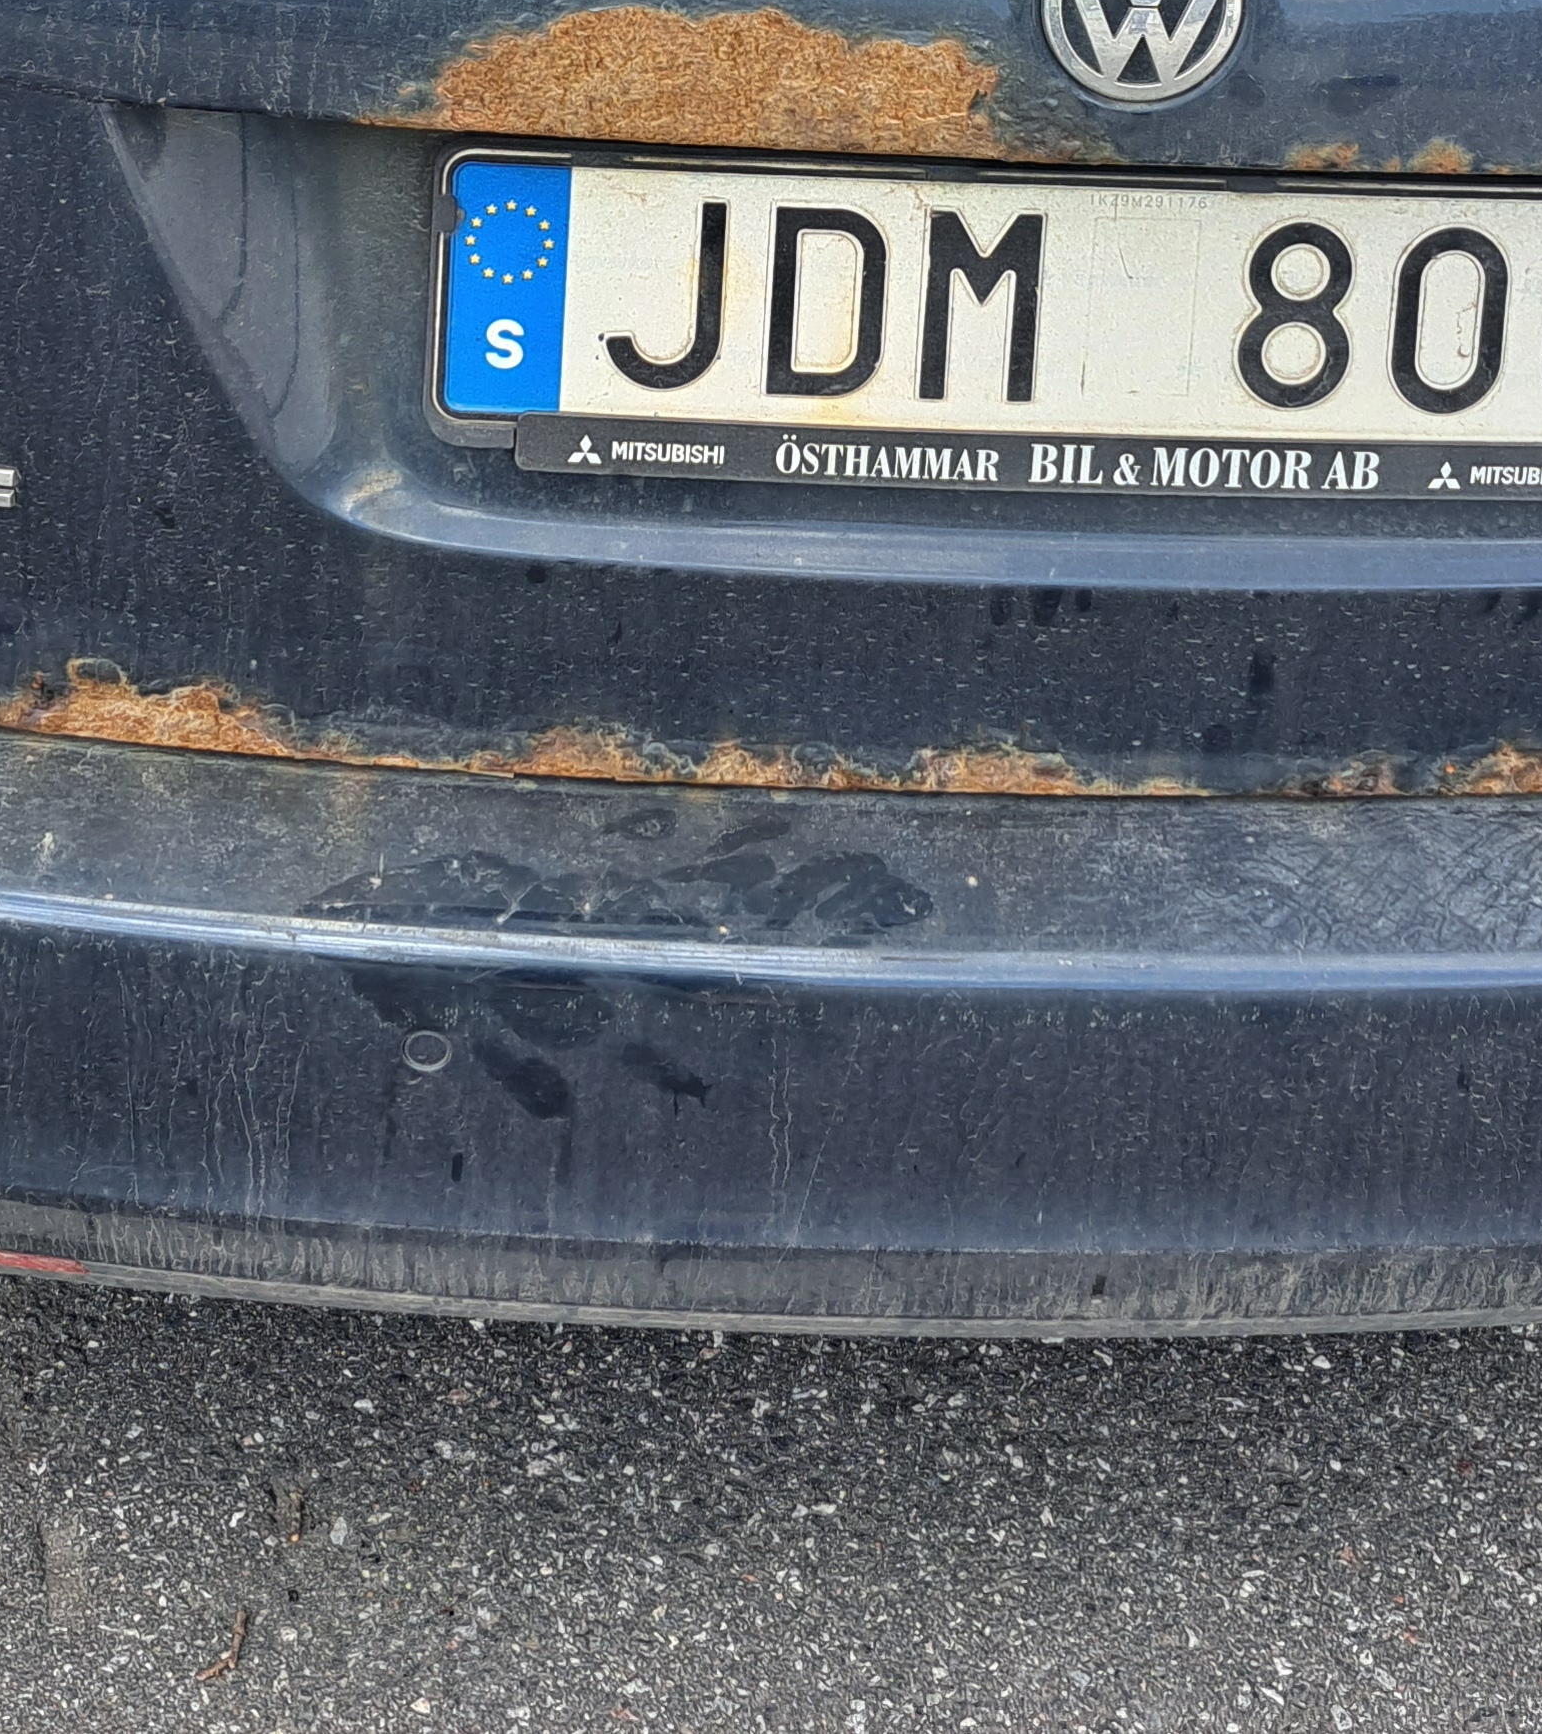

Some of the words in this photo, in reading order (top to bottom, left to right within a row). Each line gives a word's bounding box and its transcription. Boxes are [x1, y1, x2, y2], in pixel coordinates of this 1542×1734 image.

[605, 202, 1046, 403] JDM
[484, 318, 526, 370] S
[610, 440, 726, 465] MITSUBISHI
[775, 433, 1000, 482] ÖSTHAMMAR
[1027, 443, 1104, 486] BIL
[1111, 452, 1142, 487] &
[1149, 446, 1312, 490] MOTOR
[1320, 450, 1381, 491] AB
